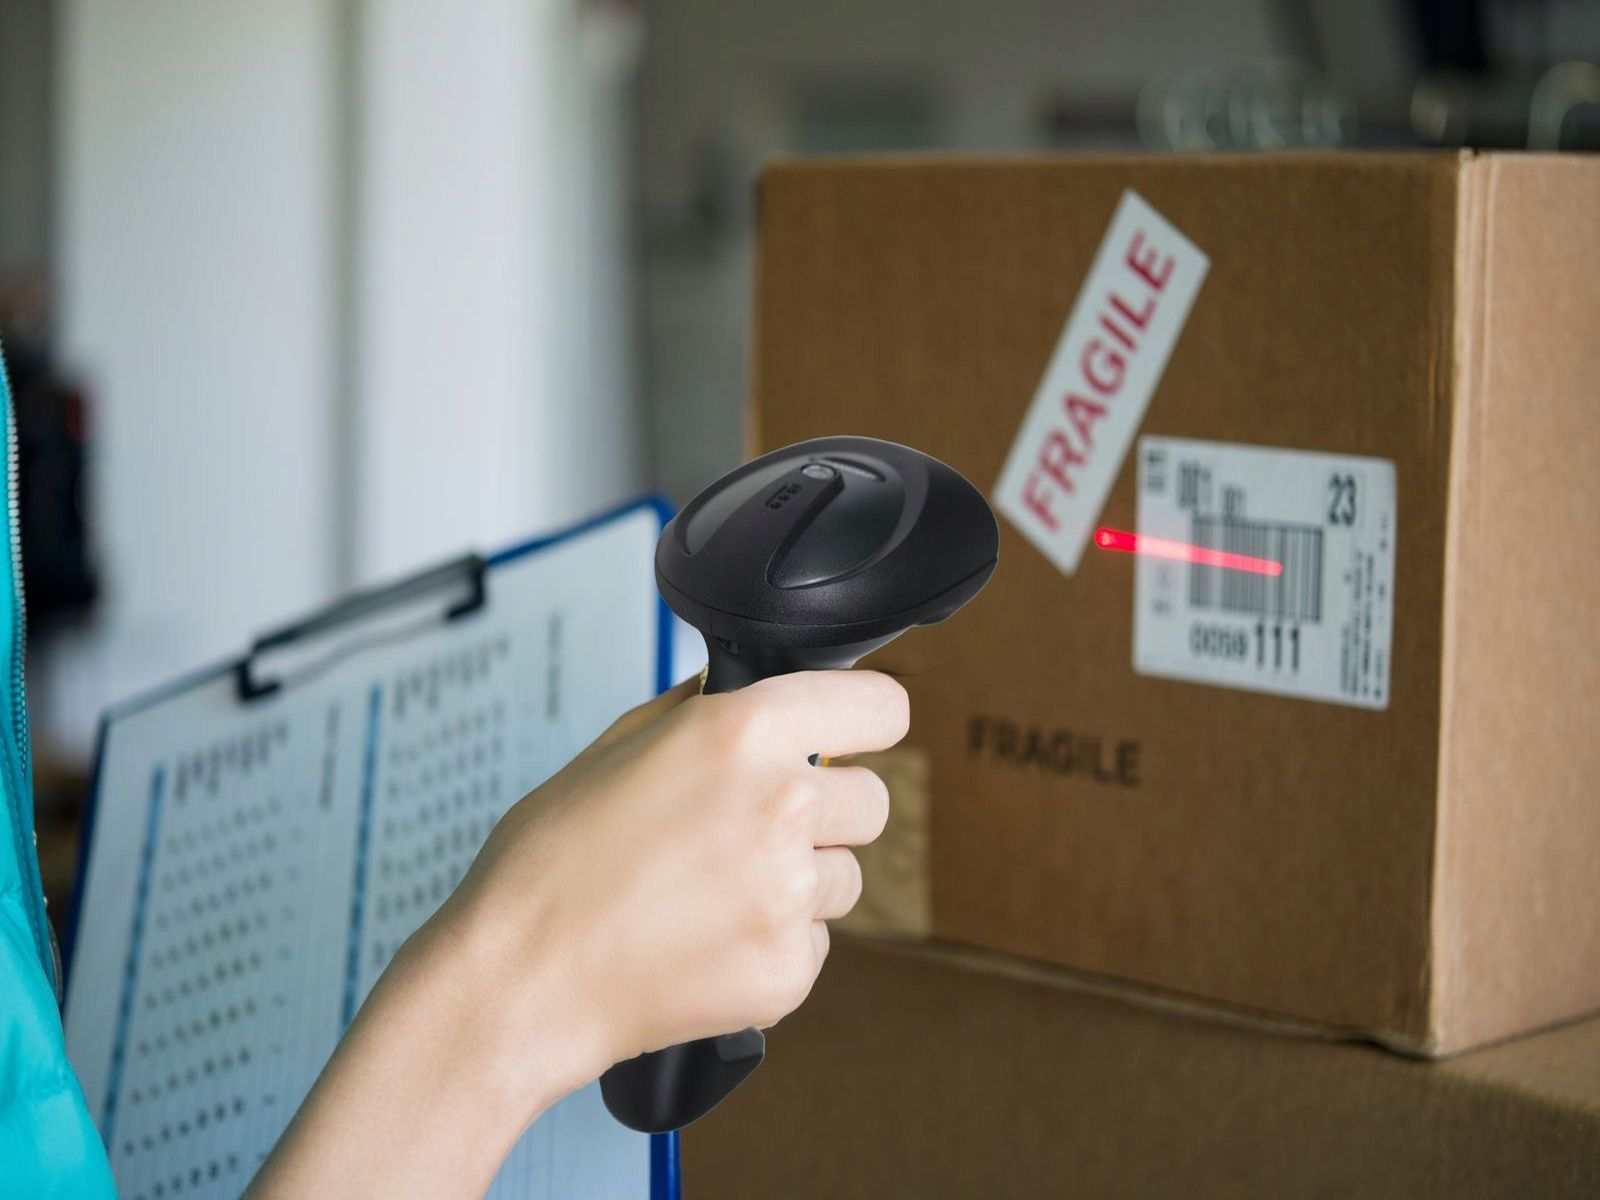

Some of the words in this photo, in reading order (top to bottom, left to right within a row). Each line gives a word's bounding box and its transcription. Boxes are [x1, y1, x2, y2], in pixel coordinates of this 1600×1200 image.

[1020, 228, 1177, 534] FRAGILE
[1326, 471, 1358, 527] 23
[967, 715, 1140, 788] FRAGILE
